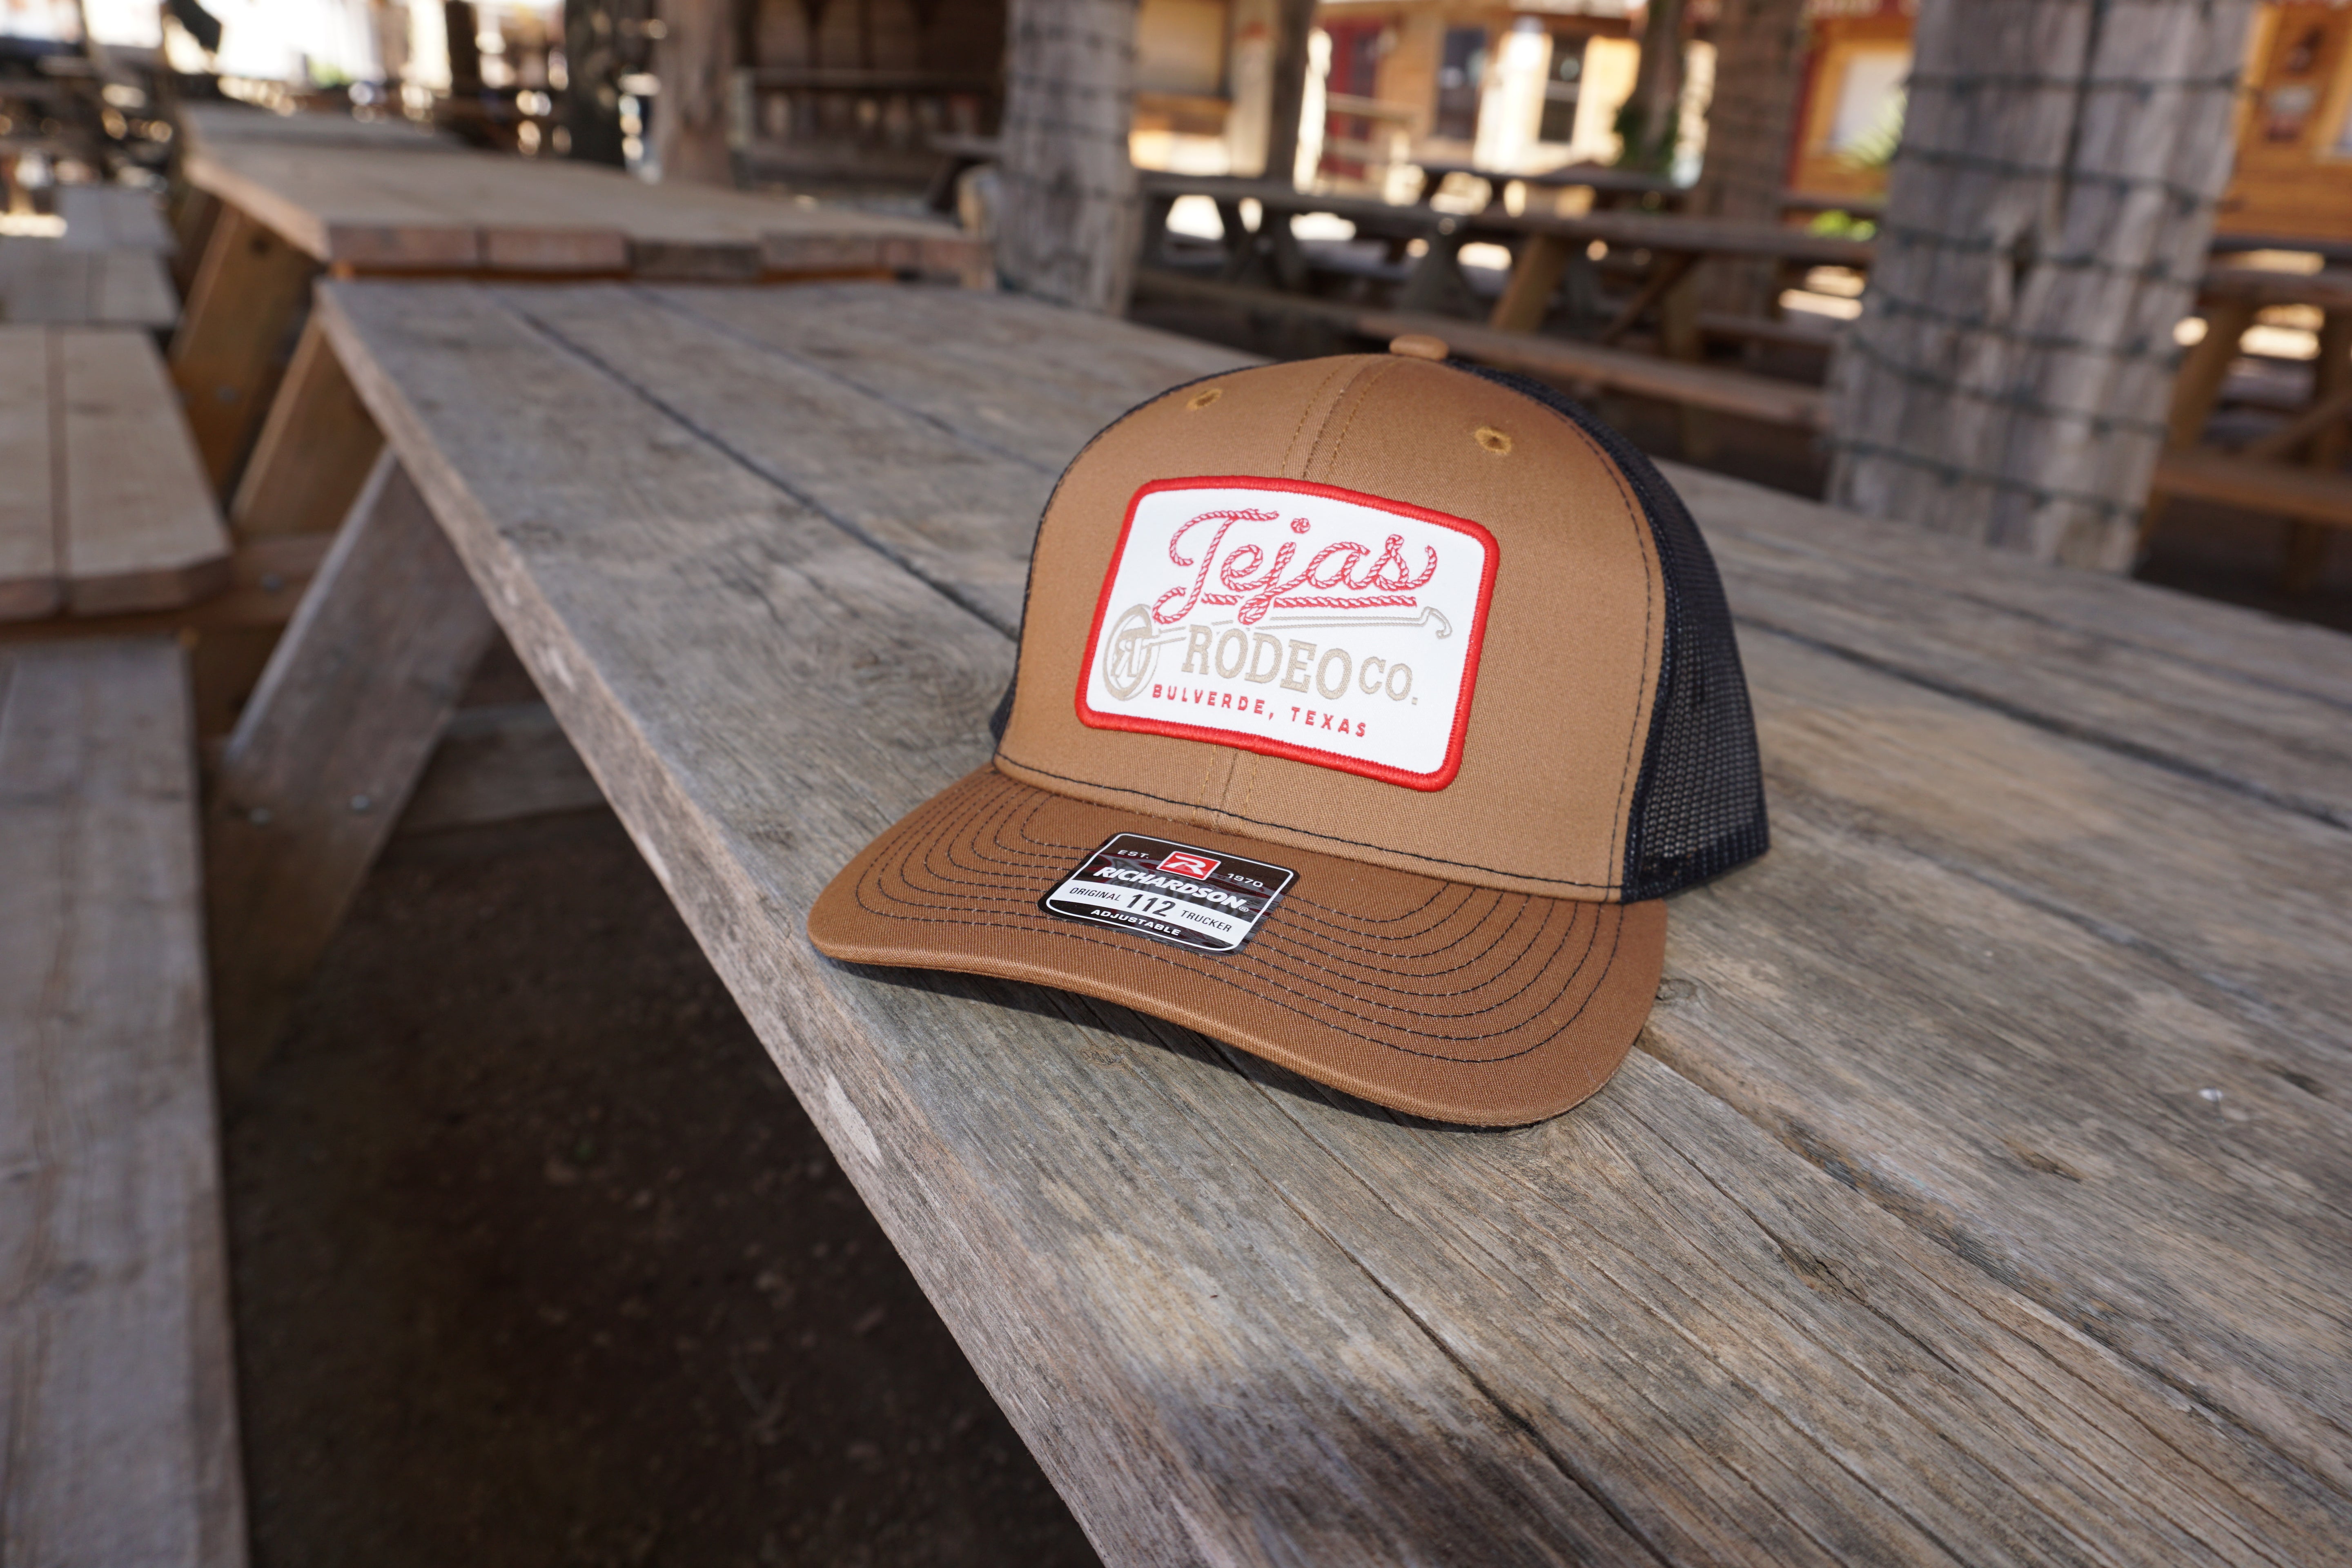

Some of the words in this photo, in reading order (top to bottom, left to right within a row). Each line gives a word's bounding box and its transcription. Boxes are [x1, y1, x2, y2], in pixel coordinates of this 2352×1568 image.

[1152, 508, 1437, 624] Tejas
[1181, 624, 1352, 699] RODEO
[1359, 656, 1418, 705] CO.
[1152, 684, 1274, 719] BULVERDE,
[1291, 706, 1366, 737] TEXAS
[1118, 850, 1149, 859] EST.
[1227, 873, 1264, 888] 1970
[1069, 887, 1120, 902] ORIGINAL
[1126, 893, 1176, 917] 112
[1181, 910, 1232, 933] TRUCKER
[1090, 909, 1181, 936] ADJUSTABLE
